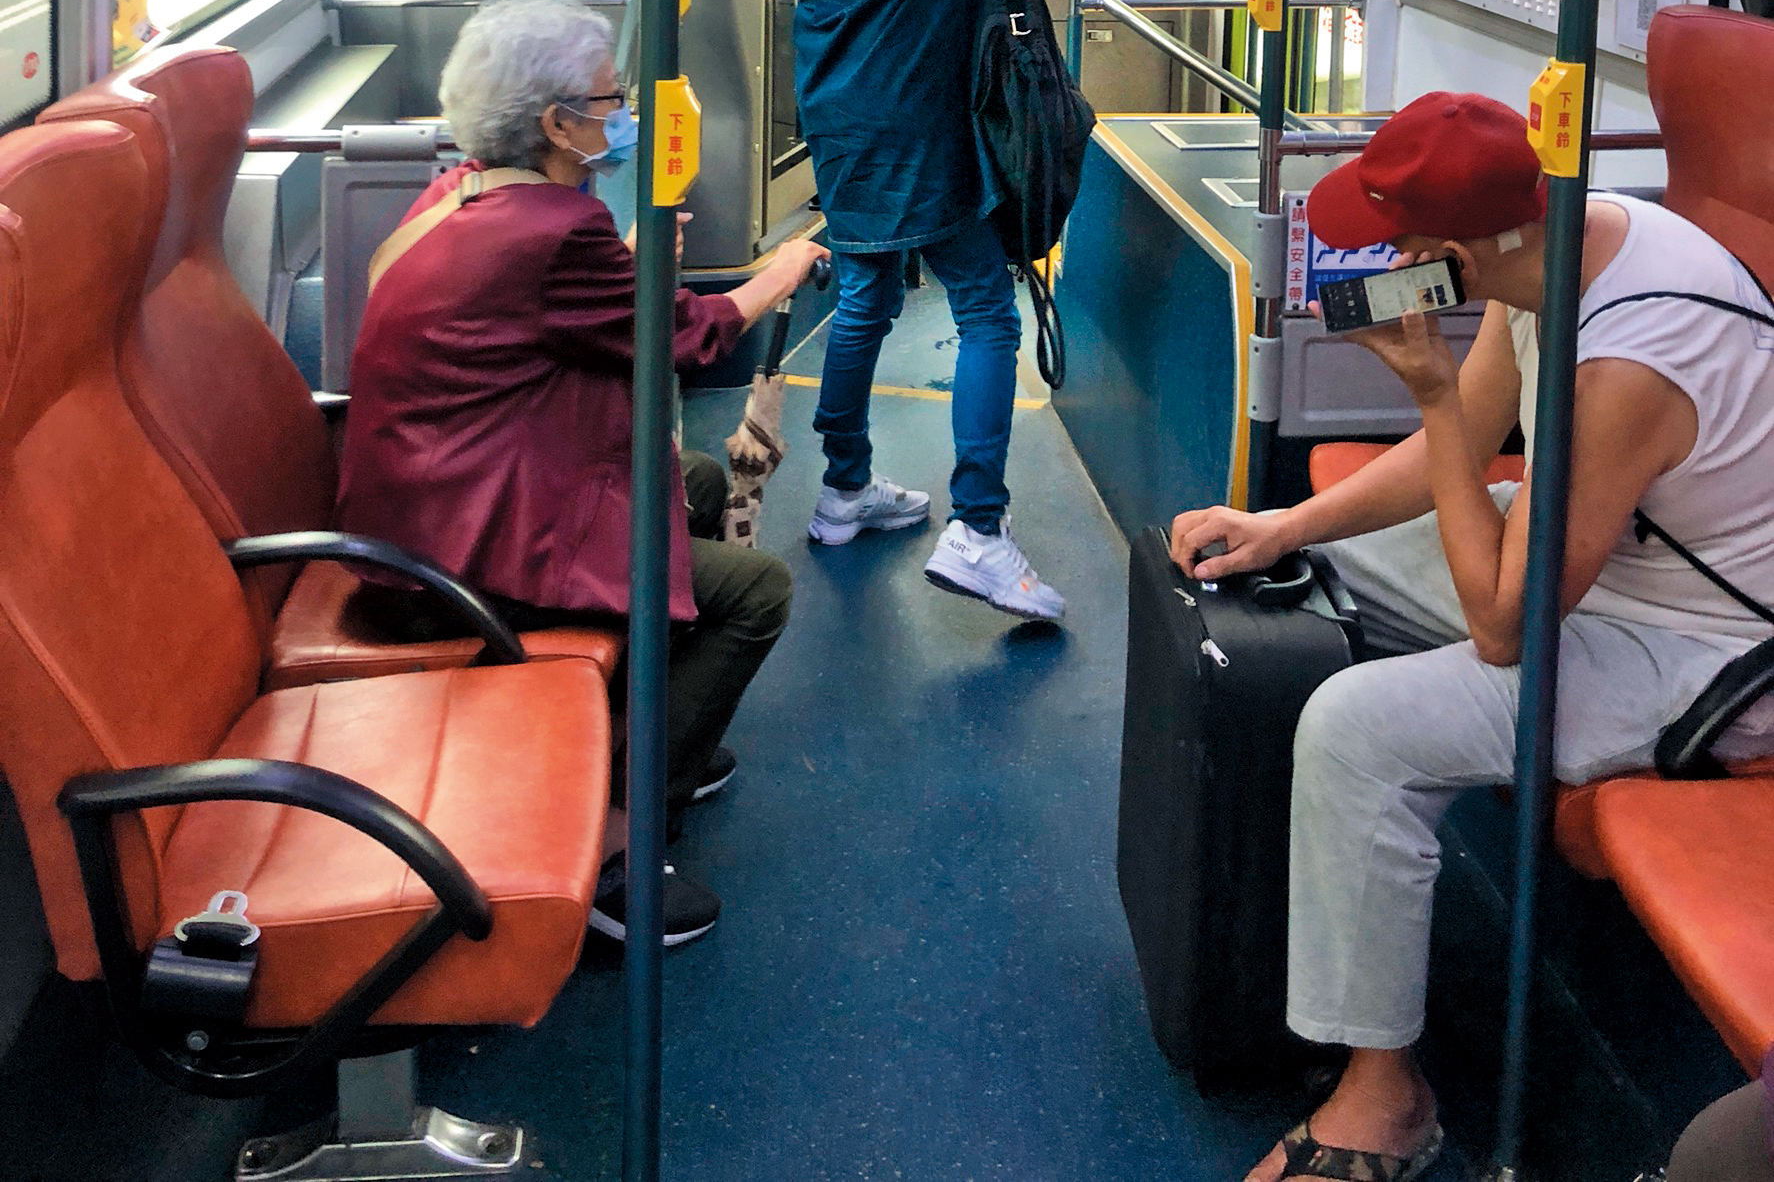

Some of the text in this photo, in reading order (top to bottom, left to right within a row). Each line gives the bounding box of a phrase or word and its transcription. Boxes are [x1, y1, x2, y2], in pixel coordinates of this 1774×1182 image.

[668, 113, 683, 175] 下車鈴
[1555, 92, 1572, 148] 下車鈴
